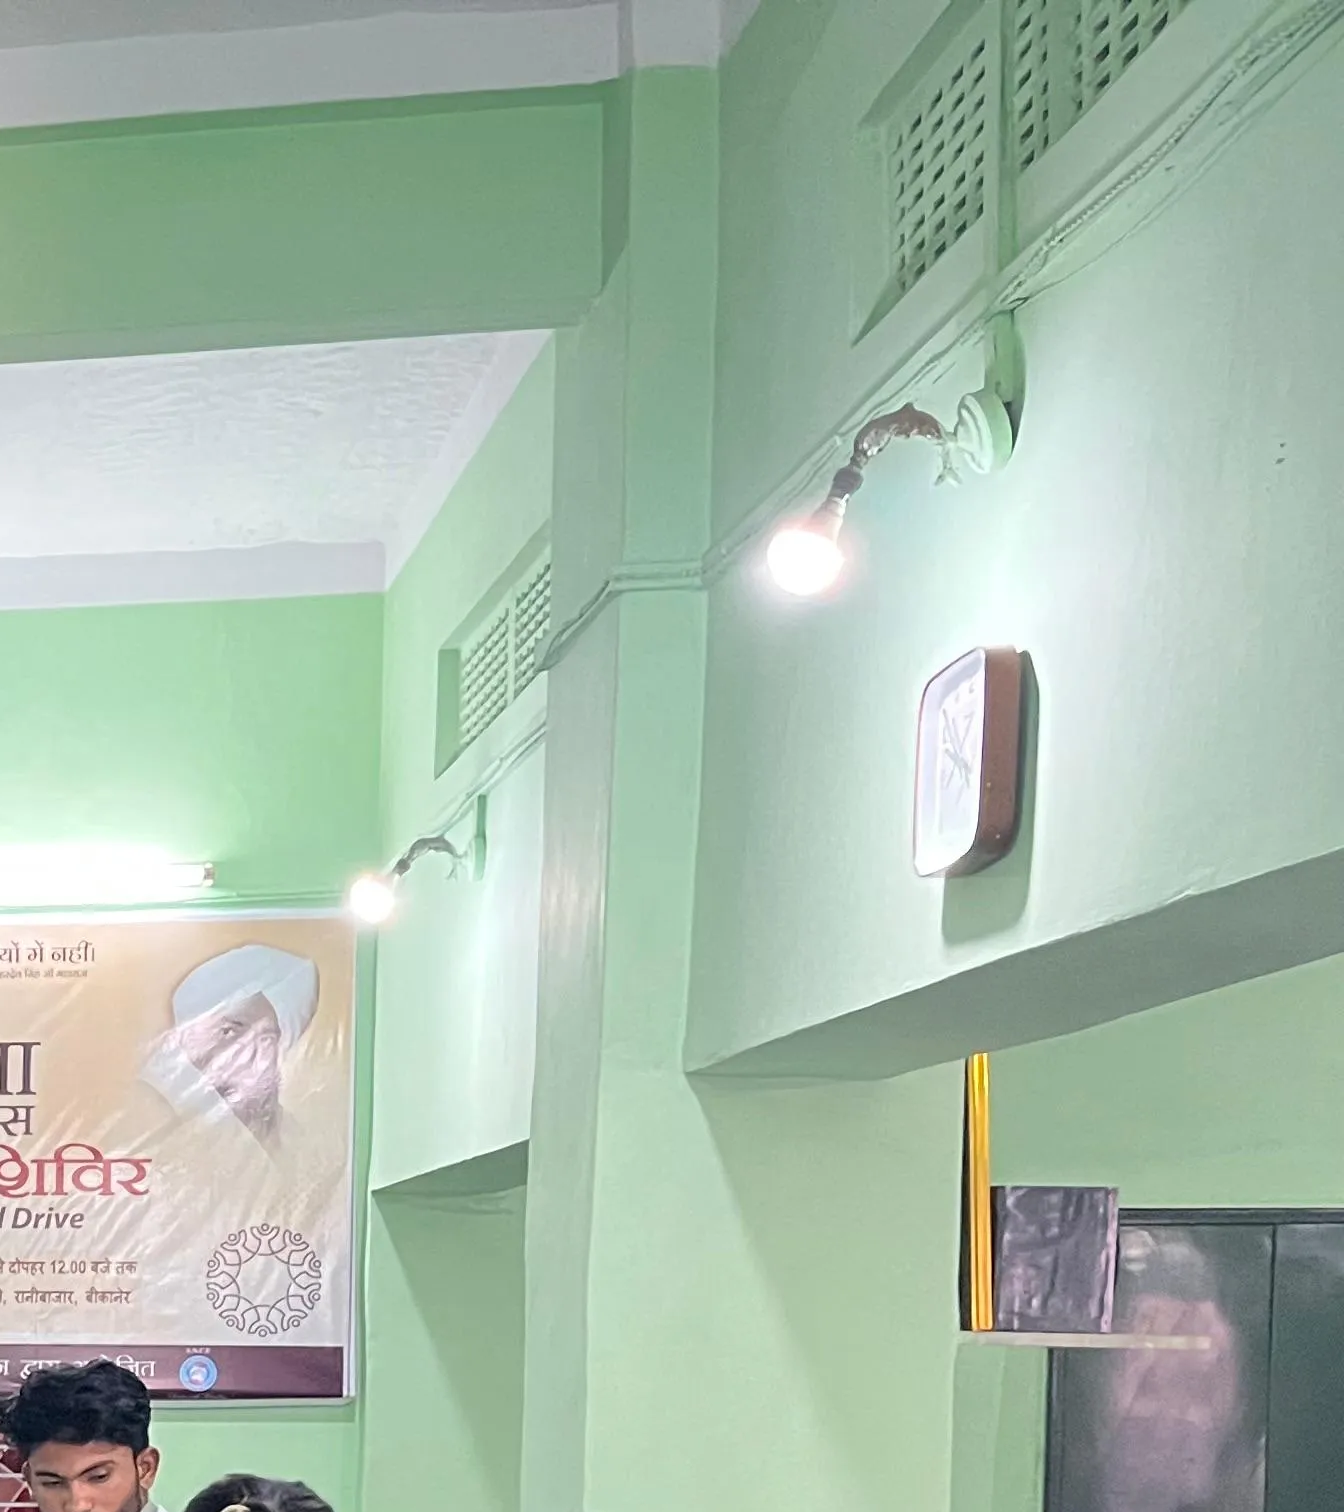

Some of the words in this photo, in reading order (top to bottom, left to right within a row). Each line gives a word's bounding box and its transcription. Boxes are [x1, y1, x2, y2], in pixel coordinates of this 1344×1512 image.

[27, 940, 45, 963] में
[11, 1206, 85, 1229] Drive
[50, 1259, 86, 1275] 12.00
